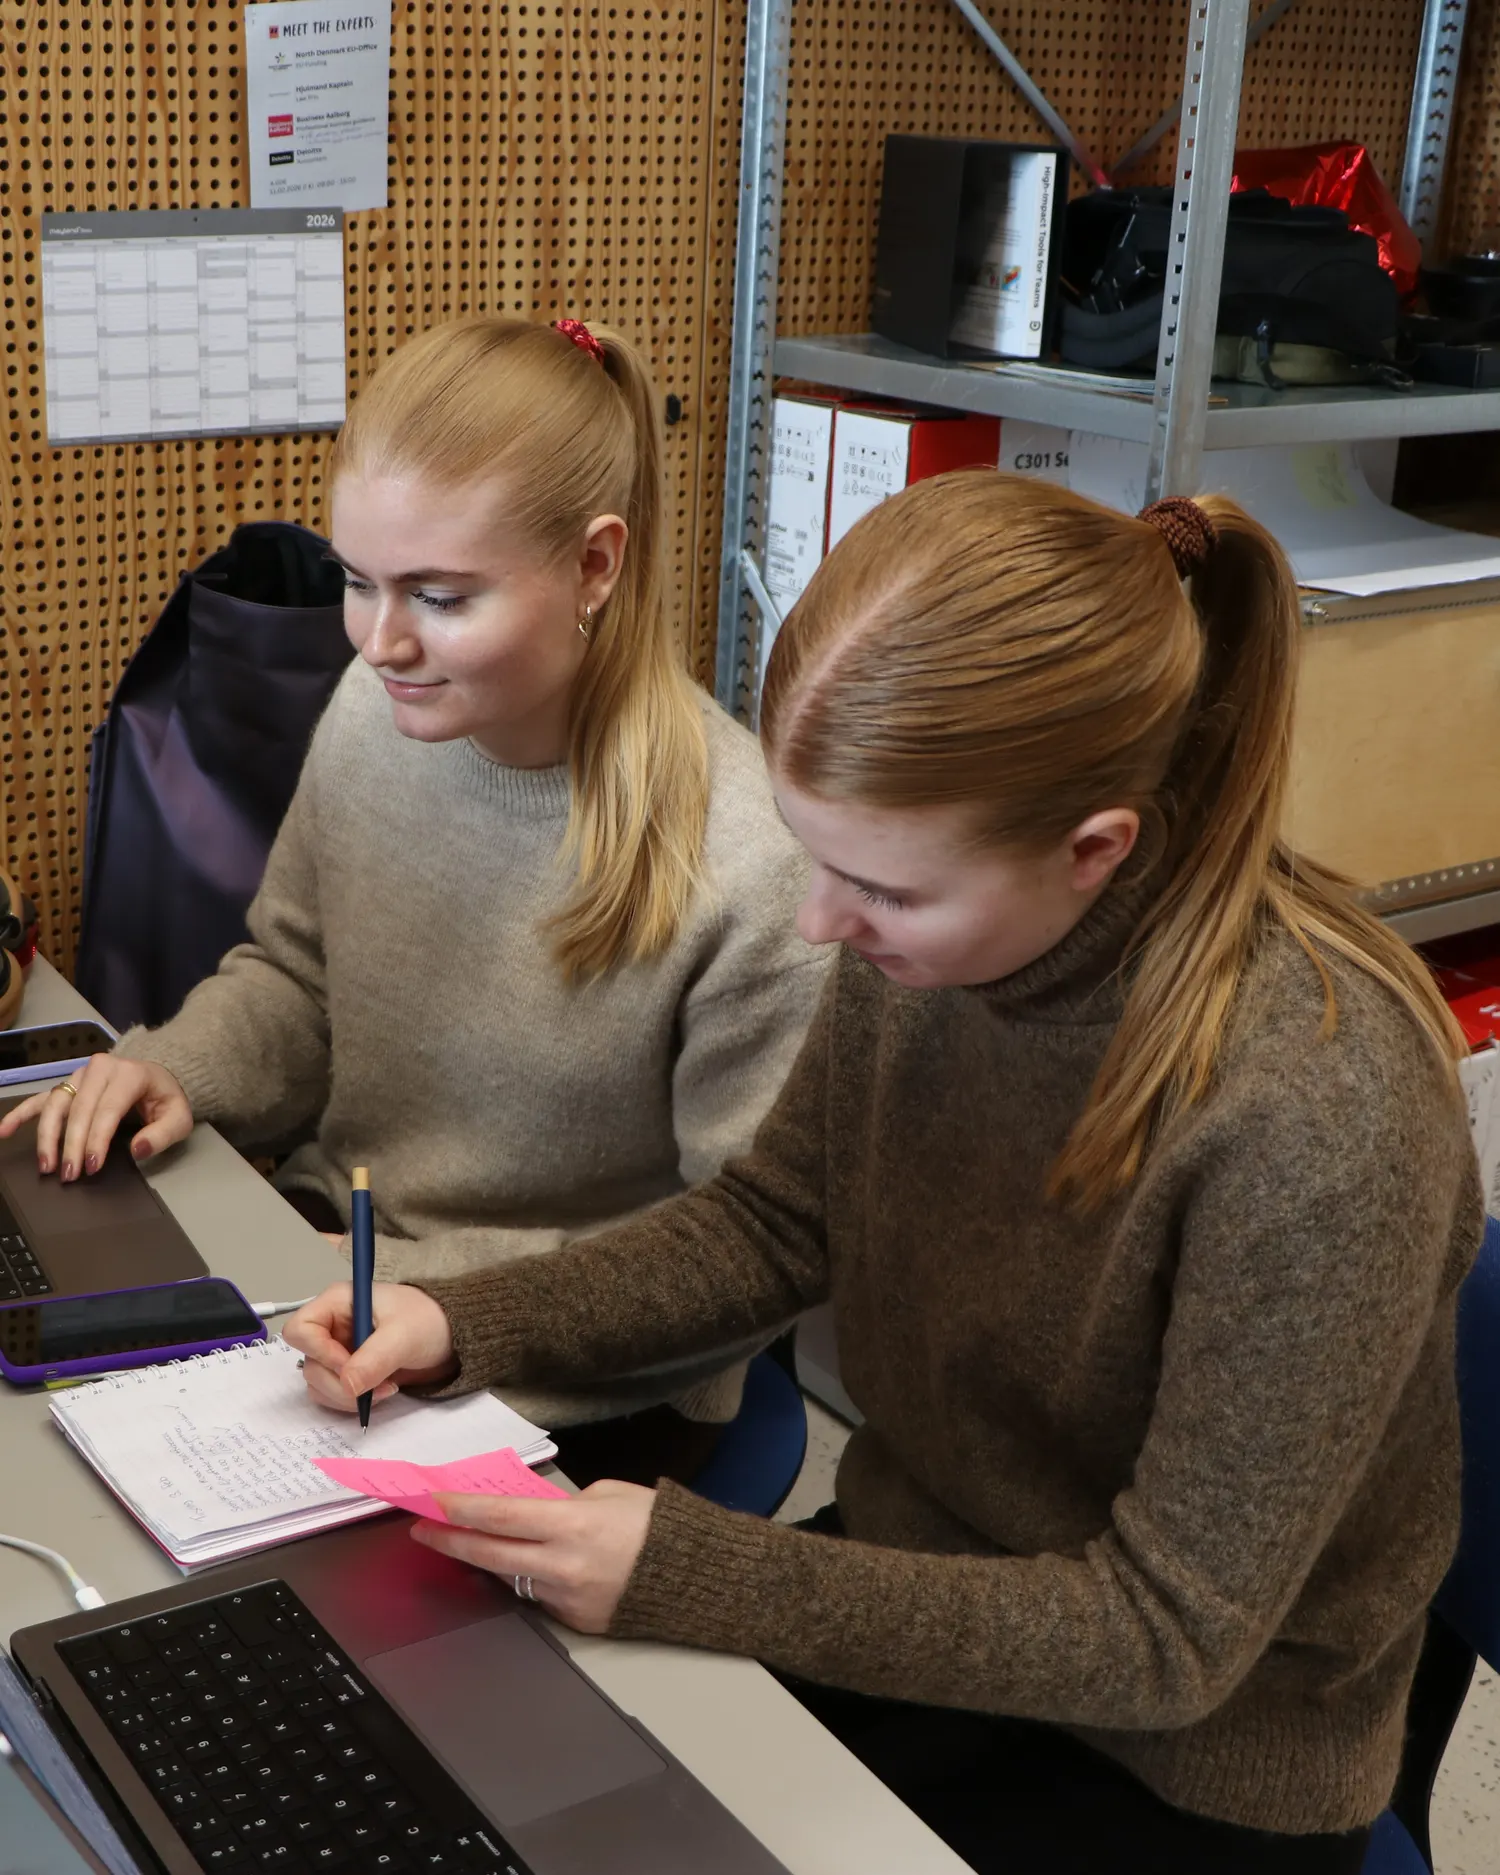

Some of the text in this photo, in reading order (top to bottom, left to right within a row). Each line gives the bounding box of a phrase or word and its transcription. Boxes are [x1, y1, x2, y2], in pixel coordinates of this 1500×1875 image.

[283, 16, 375, 37] MEET THE EXPERTS
[296, 49, 316, 59] North
[316, 47, 346, 57] Denmark
[306, 214, 336, 227] 2026
[1038, 230, 1047, 257] Tools
[1034, 276, 1043, 308] Teams
[1014, 452, 1050, 469] C301
[325, 1651, 341, 1667] option
[237, 1674, 251, 1683] Æ
[342, 1673, 365, 1696] command
[204, 1693, 216, 1702] P
[257, 1698, 268, 1707] L
[221, 1717, 234, 1725] O
[274, 1723, 287, 1732] K
[322, 1722, 336, 1732] M
[197, 1740, 210, 1748] 9
[343, 1747, 356, 1757] N
[216, 1765, 228, 1774] 8
[259, 1767, 272, 1776] U
[313, 1773, 327, 1783] H
[364, 1773, 377, 1782] B
[278, 1794, 291, 1802] Y
[334, 1799, 347, 1809] G
[384, 1800, 397, 1809] V
[254, 1818, 267, 1827] 6
[298, 1821, 311, 1829] T
[407, 1826, 420, 1835] C
[475, 1830, 501, 1857] command
[274, 1846, 287, 1855] 5
[319, 1847, 333, 1857] R
[377, 1854, 391, 1864] D
[429, 1853, 443, 1863] X
